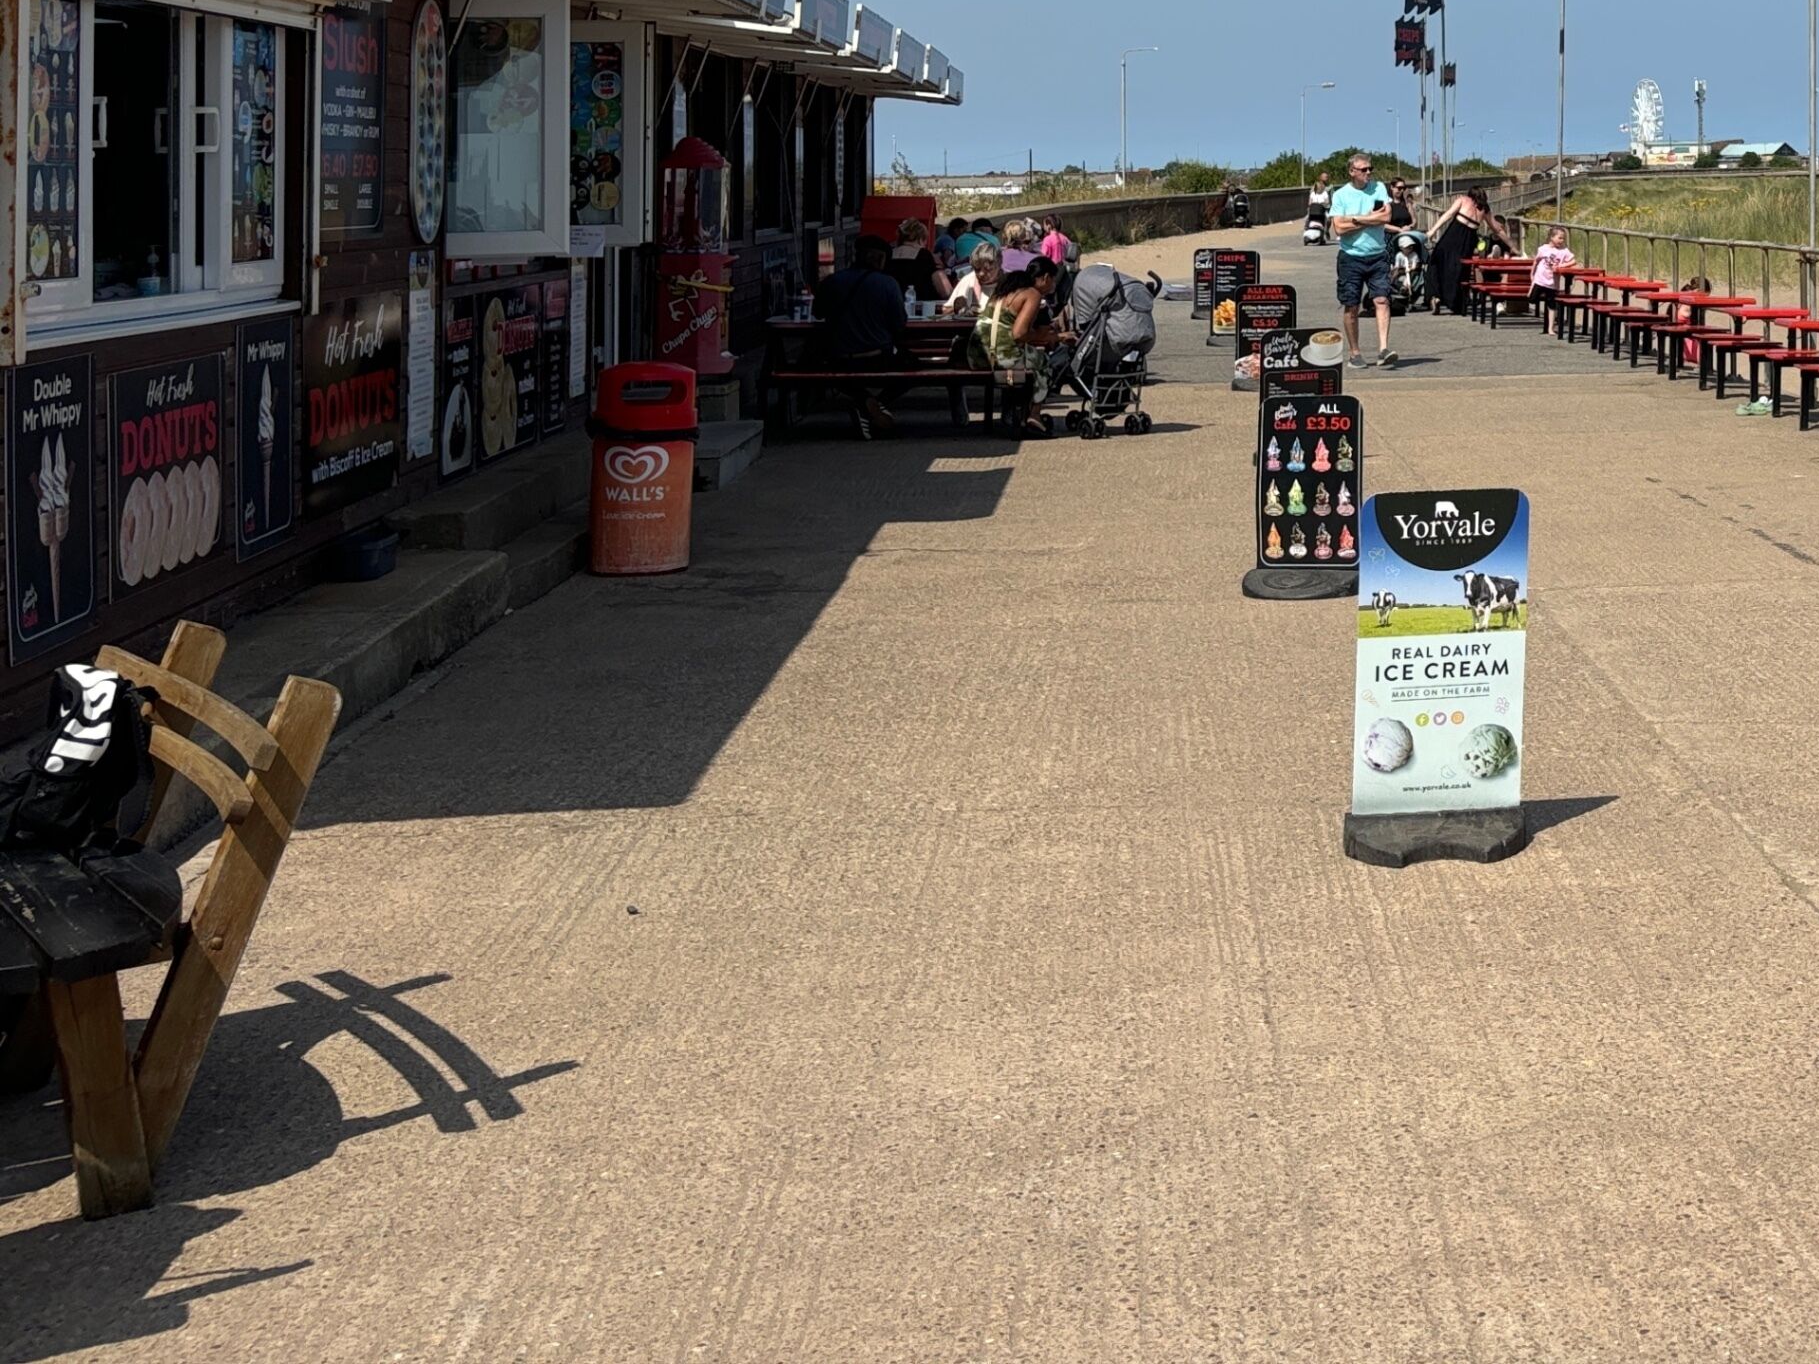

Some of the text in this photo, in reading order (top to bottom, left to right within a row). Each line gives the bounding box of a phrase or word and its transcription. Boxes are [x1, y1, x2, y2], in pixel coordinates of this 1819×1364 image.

[324, 14, 378, 75] Slush
[324, 320, 350, 368] Hot
[350, 303, 385, 361] Fresh
[247, 338, 286, 364] Mr Whippy
[1263, 355, 1300, 368] Café
[33, 372, 73, 402] Double
[145, 362, 196, 409] Hot Fresh
[22, 401, 83, 434] Mr Whippy
[309, 368, 396, 448] DONUTS
[1318, 403, 1341, 414] ALL
[1274, 420, 1297, 430] Café
[1305, 417, 1351, 430] £3.50
[120, 400, 218, 477] DONUTS
[311, 458, 330, 485] with
[605, 486, 665, 502] WALL'S
[1393, 511, 1496, 539] Yorvale
[1415, 538, 1446, 547] SINCE
[1392, 643, 1492, 660] REAL DAIRY
[1375, 658, 1510, 682] ICE CREAM
[1391, 685, 1491, 699] MADE ON THE FARM
